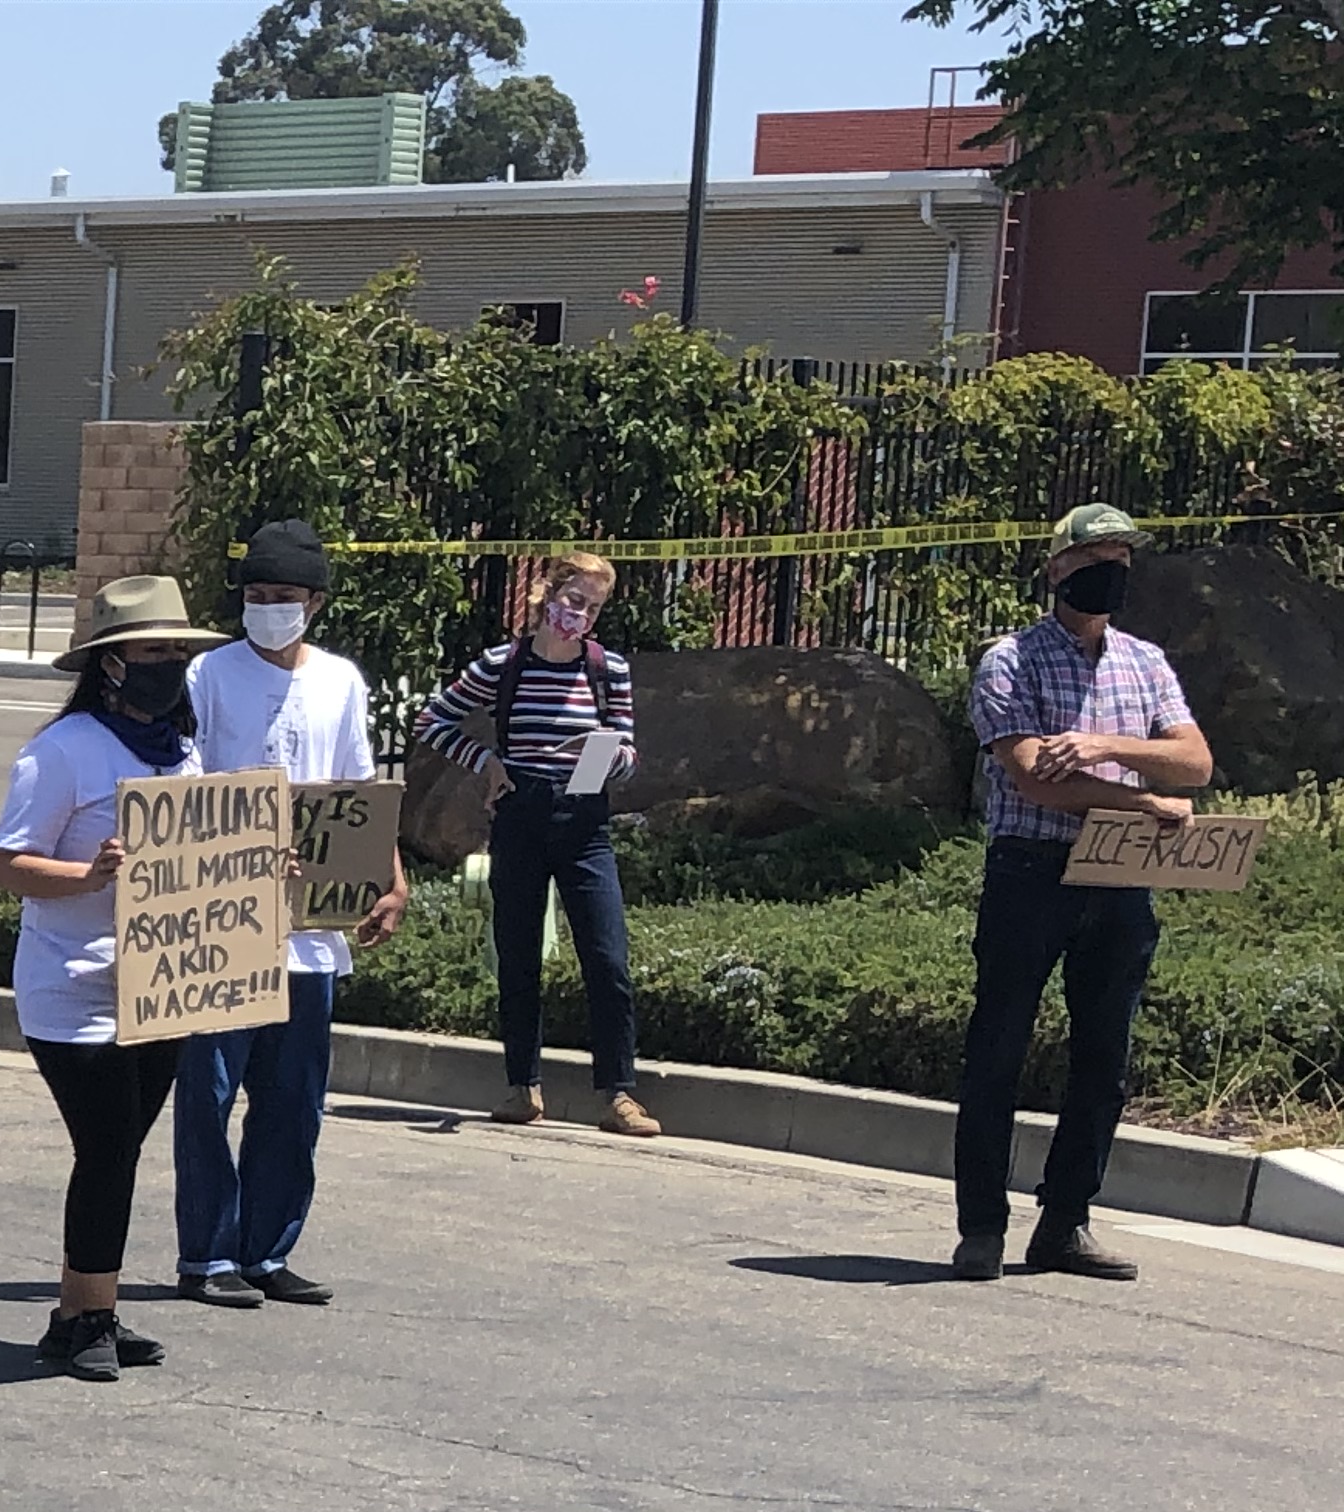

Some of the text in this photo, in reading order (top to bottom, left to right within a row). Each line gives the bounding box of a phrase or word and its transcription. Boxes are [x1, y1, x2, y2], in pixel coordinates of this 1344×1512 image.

[122, 790, 175, 855] DO
[129, 855, 191, 904] STILL
[122, 896, 263, 955] ASKING FOR
[149, 944, 229, 988] A KID
[136, 994, 160, 1026] IN
[164, 988, 183, 1019] A
